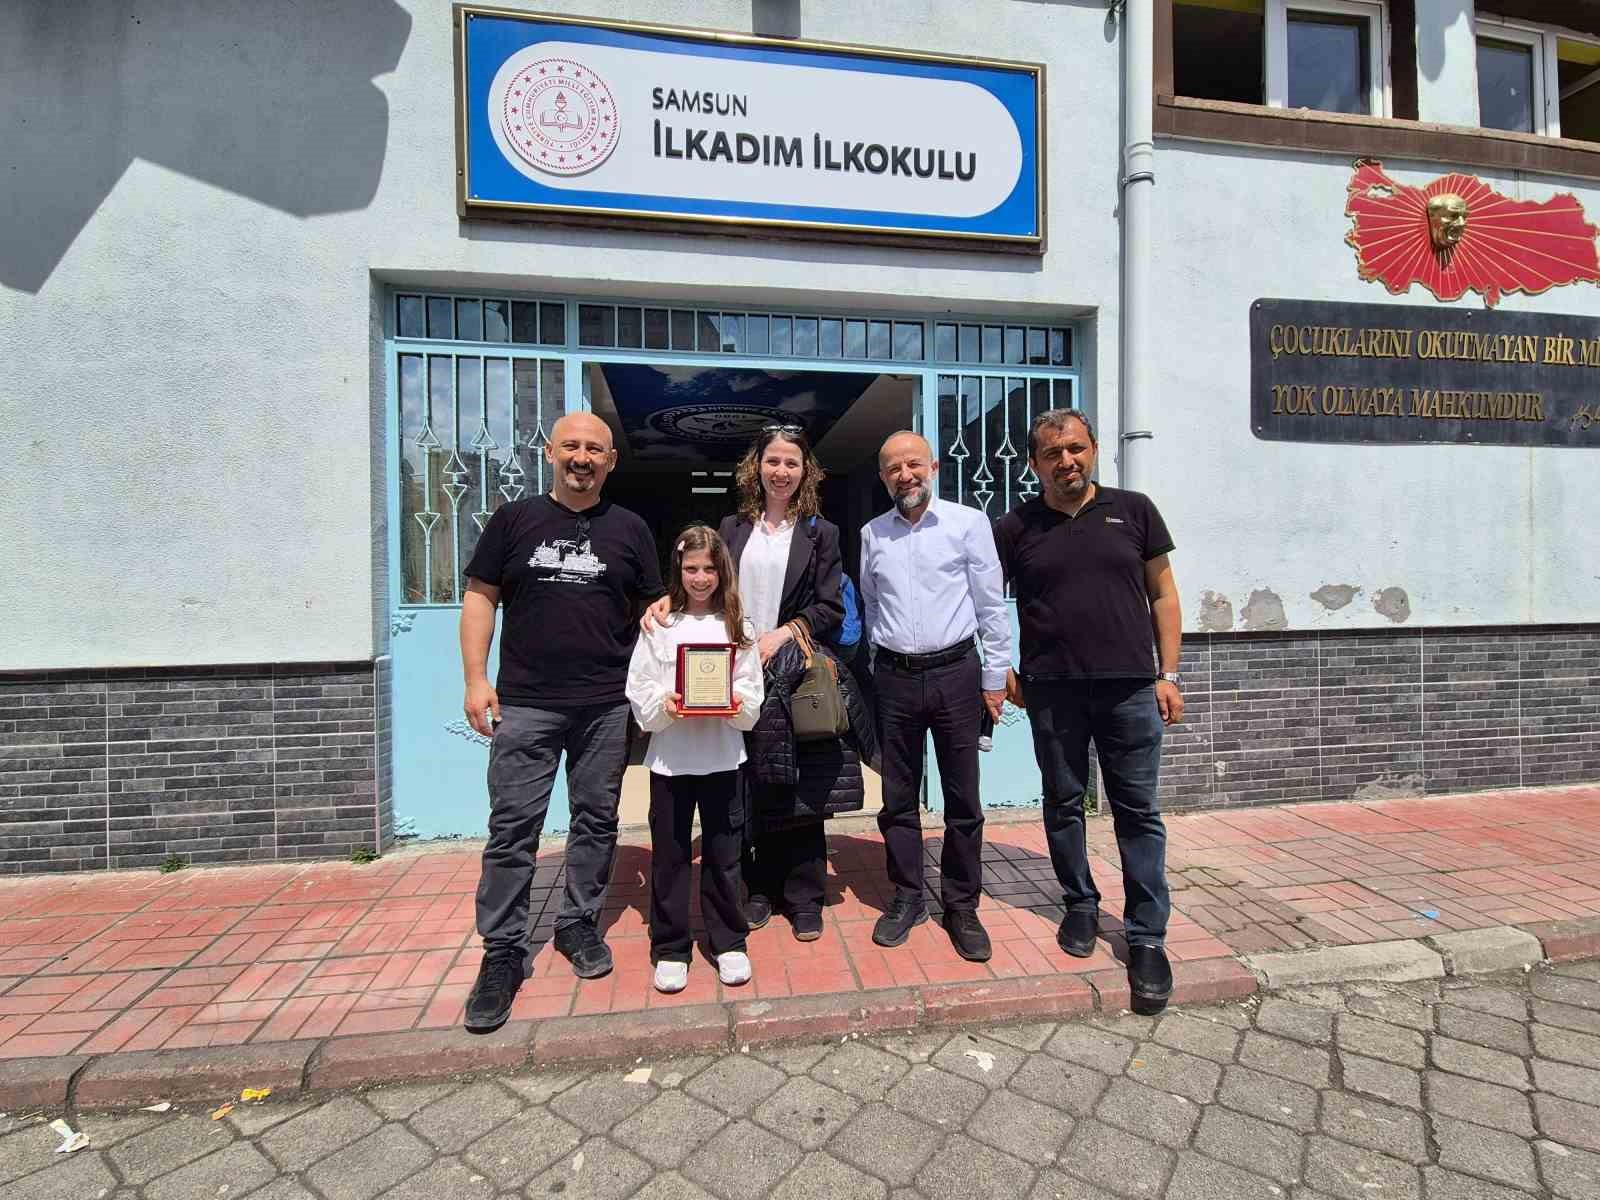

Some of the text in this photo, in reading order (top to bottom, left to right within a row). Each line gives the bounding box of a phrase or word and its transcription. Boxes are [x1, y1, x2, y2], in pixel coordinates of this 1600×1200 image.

[652, 86, 748, 117] SAMSUN
[654, 118, 976, 182] İLKADIM İLKOKULU
[1270, 324, 1413, 360] ÇOCUKLARINI
[1417, 329, 1539, 363] OKUTMAYAN
[1541, 332, 1576, 365] BİR
[1271, 384, 1317, 416] YOK
[1321, 385, 1405, 417] OLMAYA
[1408, 387, 1545, 422] MAHKUMDUR
